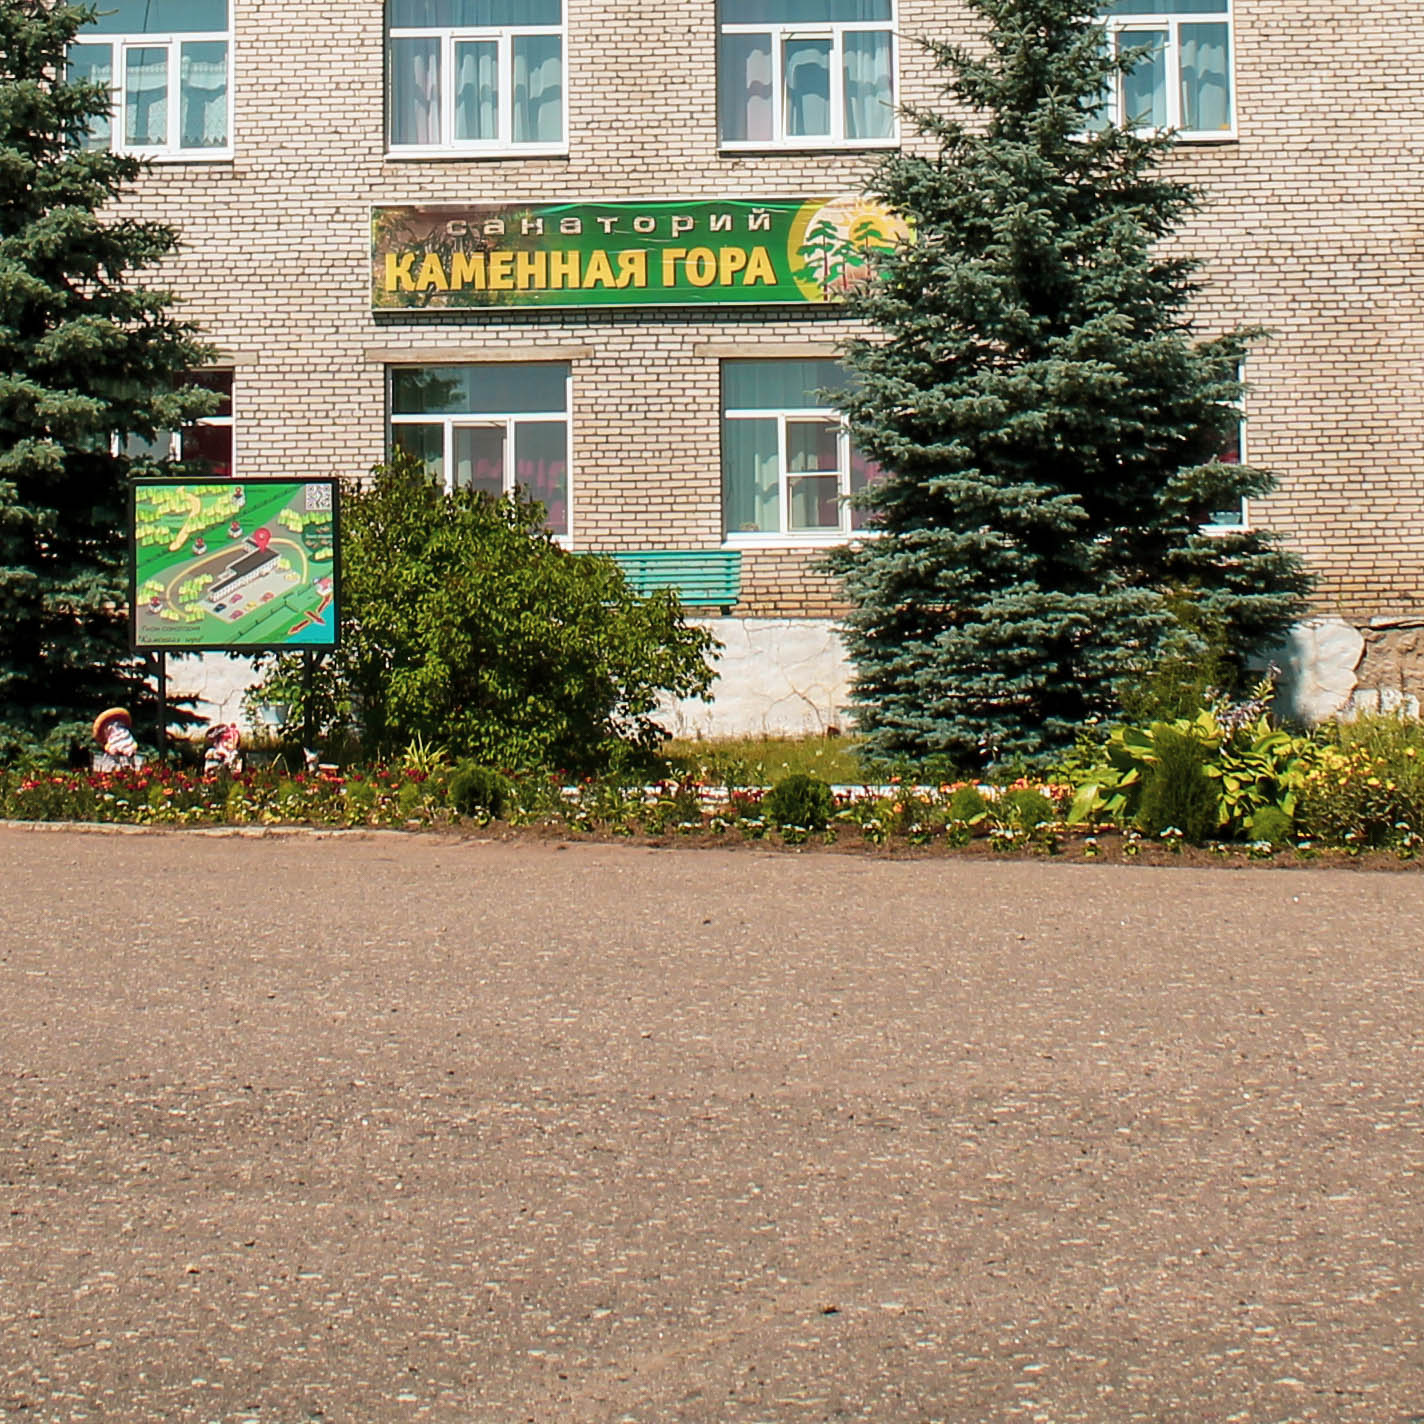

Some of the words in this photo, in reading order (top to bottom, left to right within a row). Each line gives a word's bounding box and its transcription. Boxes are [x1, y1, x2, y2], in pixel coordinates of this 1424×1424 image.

[446, 207, 773, 238] санаторий
[384, 248, 647, 292] КАМЕННАЯ
[661, 245, 778, 287] ГОРА
